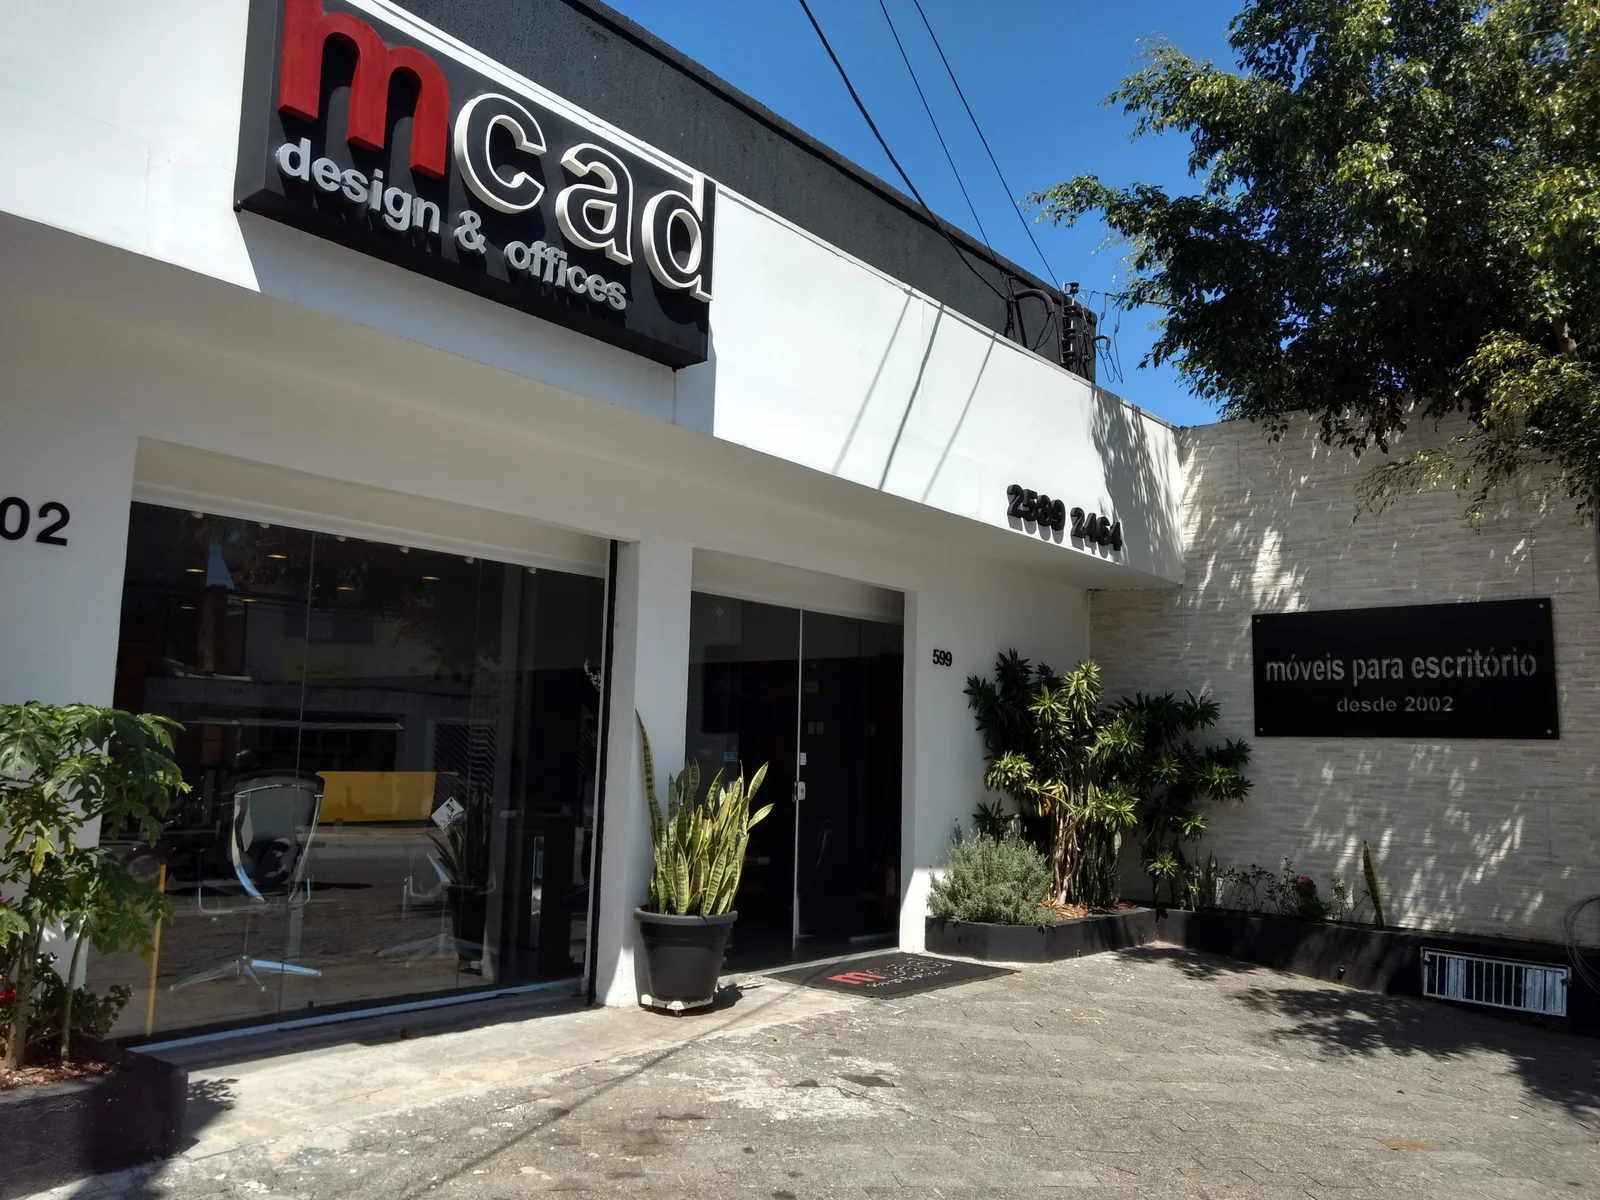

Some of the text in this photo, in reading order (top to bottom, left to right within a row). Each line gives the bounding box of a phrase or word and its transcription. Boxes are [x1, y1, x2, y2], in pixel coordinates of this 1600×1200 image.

[275, 138, 627, 311] design & offices
[0, 496, 70, 546] 02
[1070, 507, 1123, 551] 2464
[932, 648, 953, 667] 599
[1265, 647, 1537, 687] móveis para escritório
[1336, 696, 1454, 712] desde 2002
